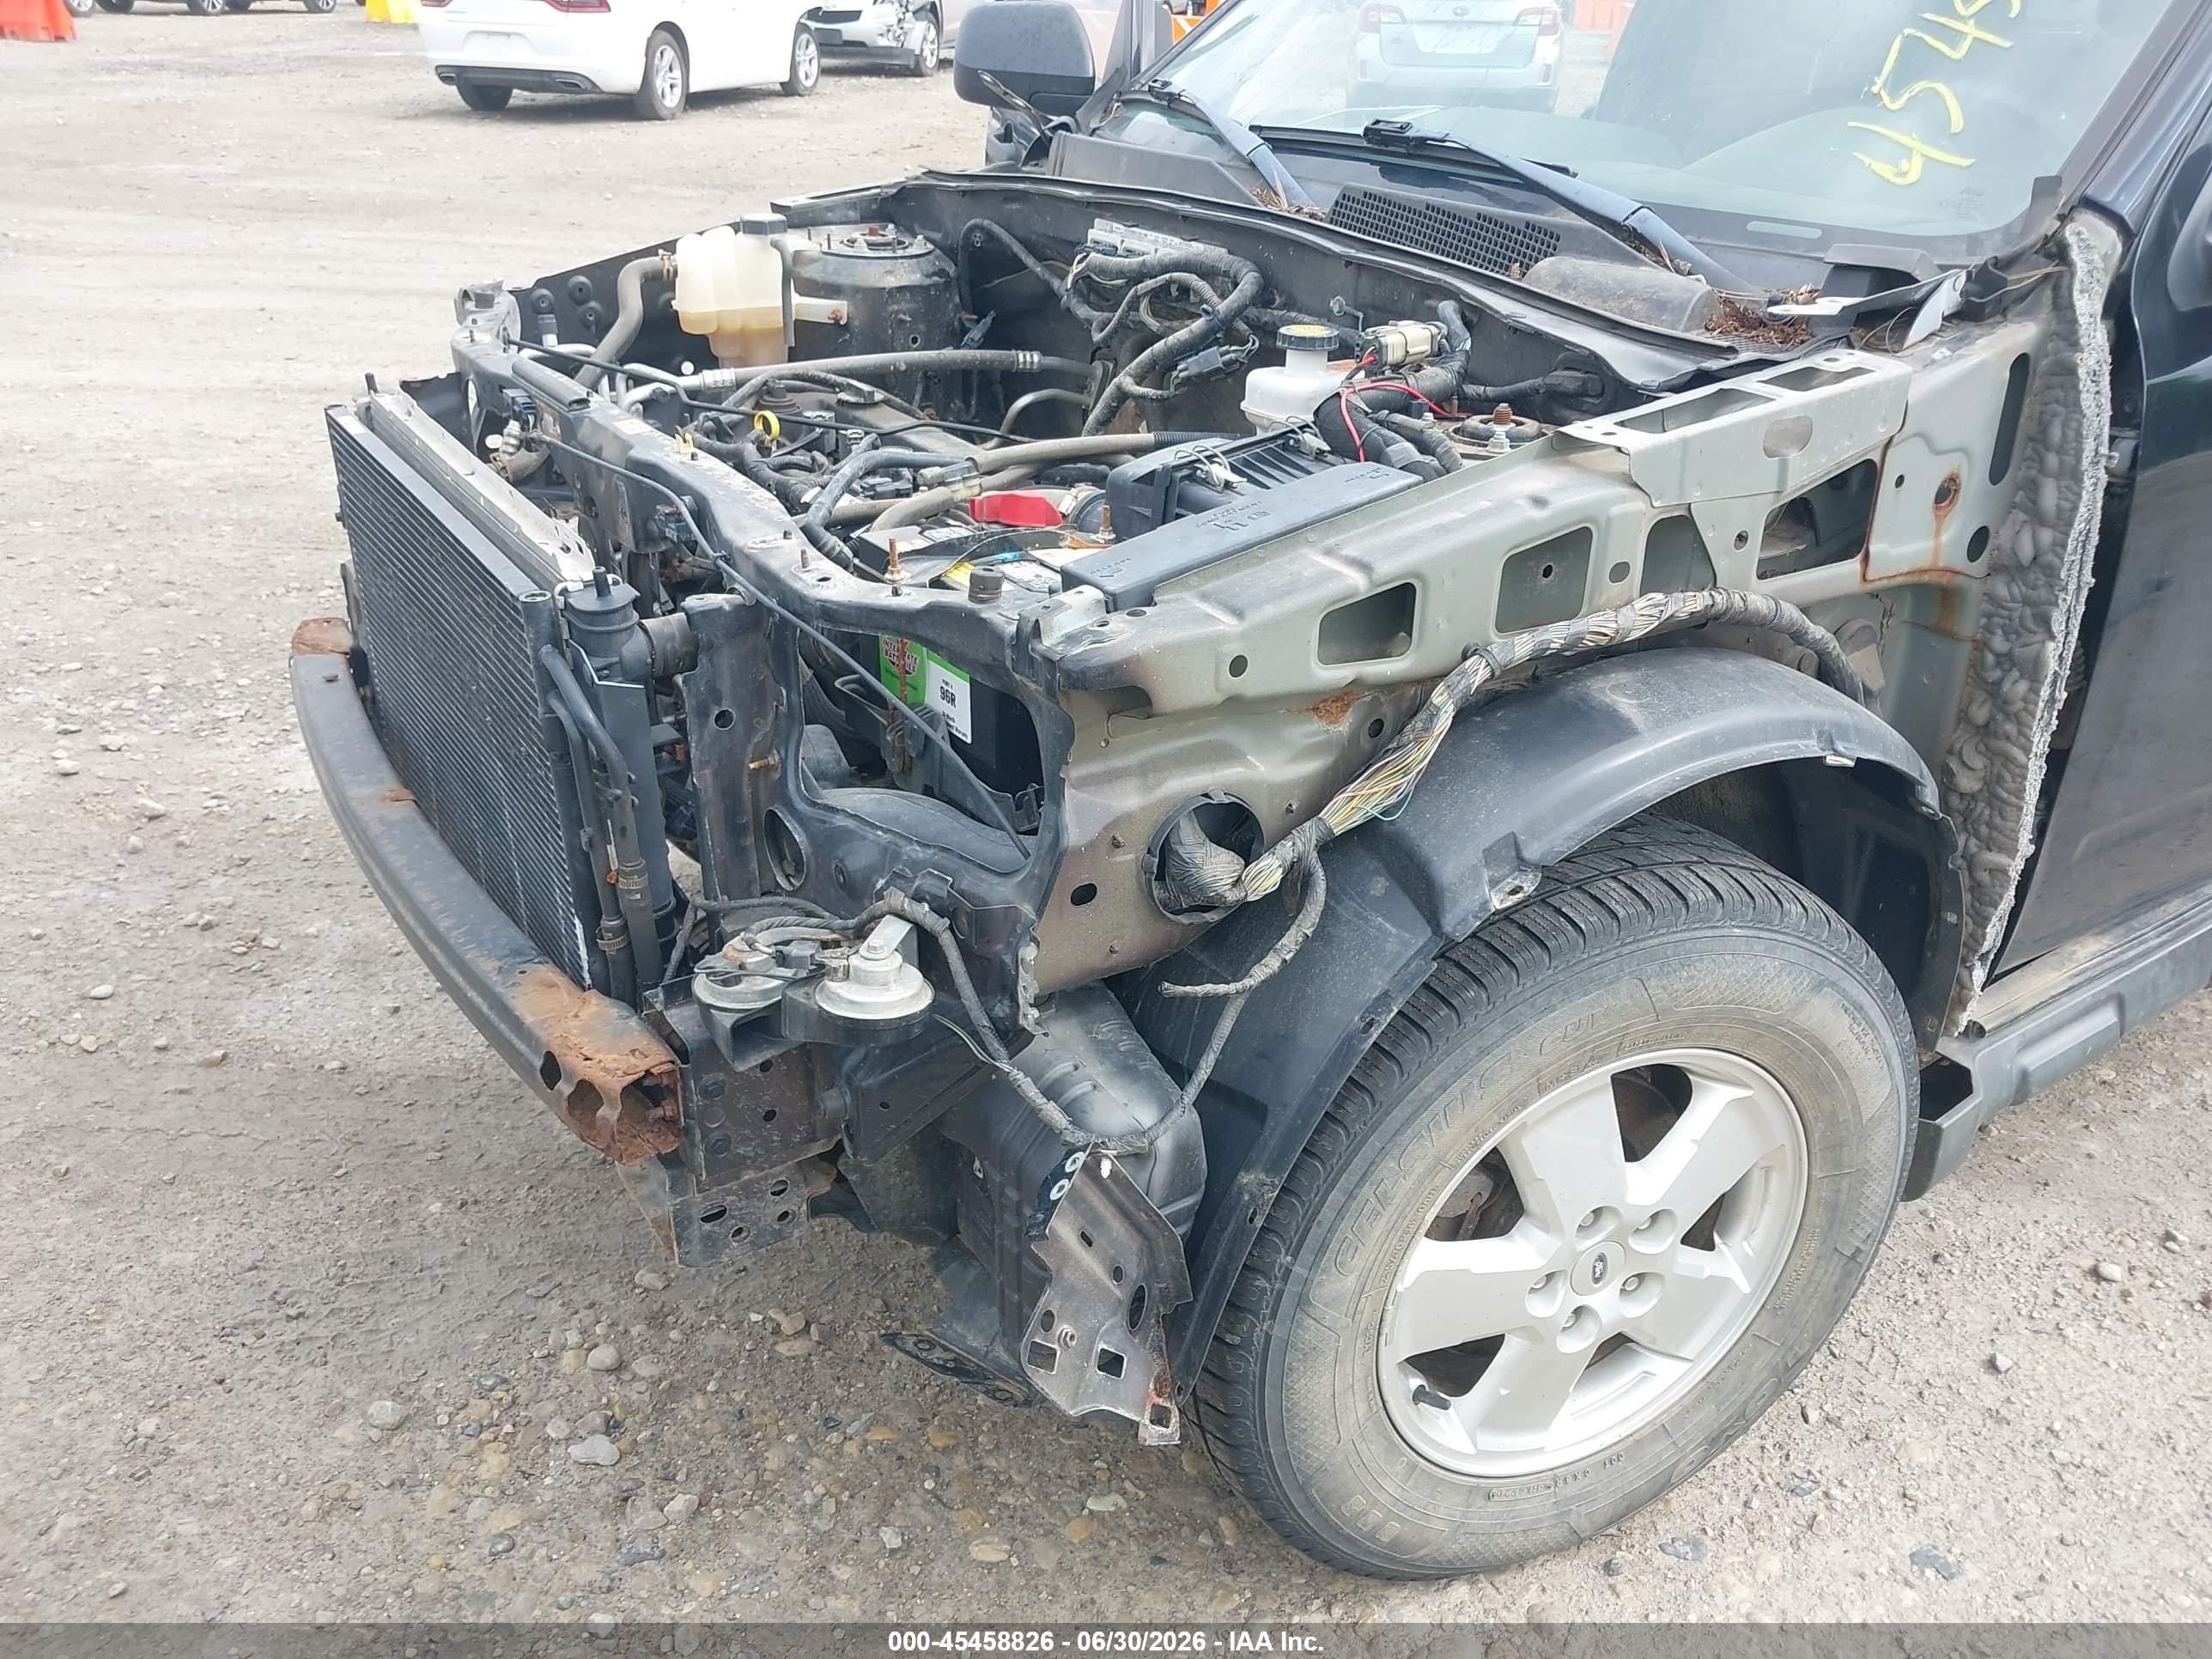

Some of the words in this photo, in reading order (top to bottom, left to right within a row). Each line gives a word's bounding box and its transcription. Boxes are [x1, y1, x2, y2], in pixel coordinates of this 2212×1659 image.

[884, 649, 916, 673] BATTIES
[939, 685, 957, 708] 96R
[1331, 1053, 1513, 1277] CELSIUS
